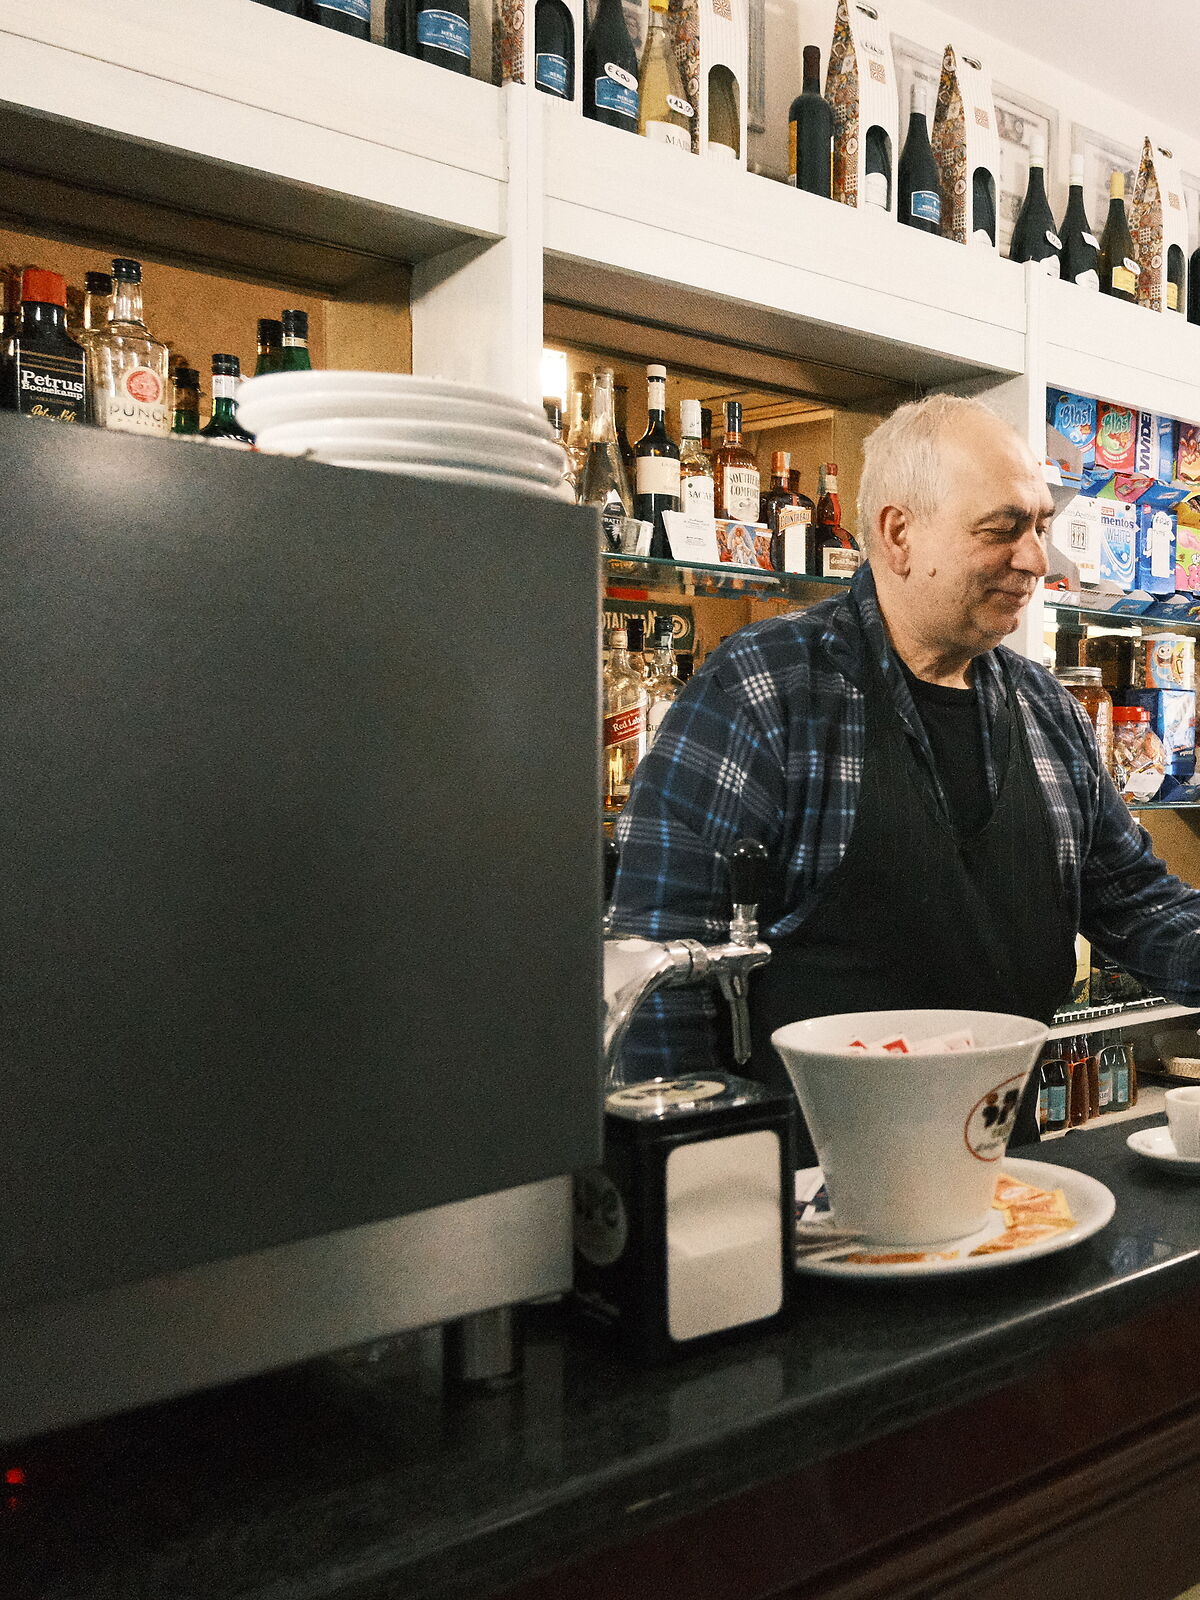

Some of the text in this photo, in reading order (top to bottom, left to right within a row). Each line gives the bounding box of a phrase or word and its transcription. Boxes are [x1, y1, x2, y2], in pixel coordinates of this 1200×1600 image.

[21, 369, 83, 392] Petrus
[21, 380, 84, 400] Boonekamp
[1060, 404, 1093, 429] Blast
[1102, 411, 1134, 436] Blast
[1101, 516, 1135, 529] mentos
[1105, 527, 1131, 544] WHITE
[612, 720, 628, 732] Red
